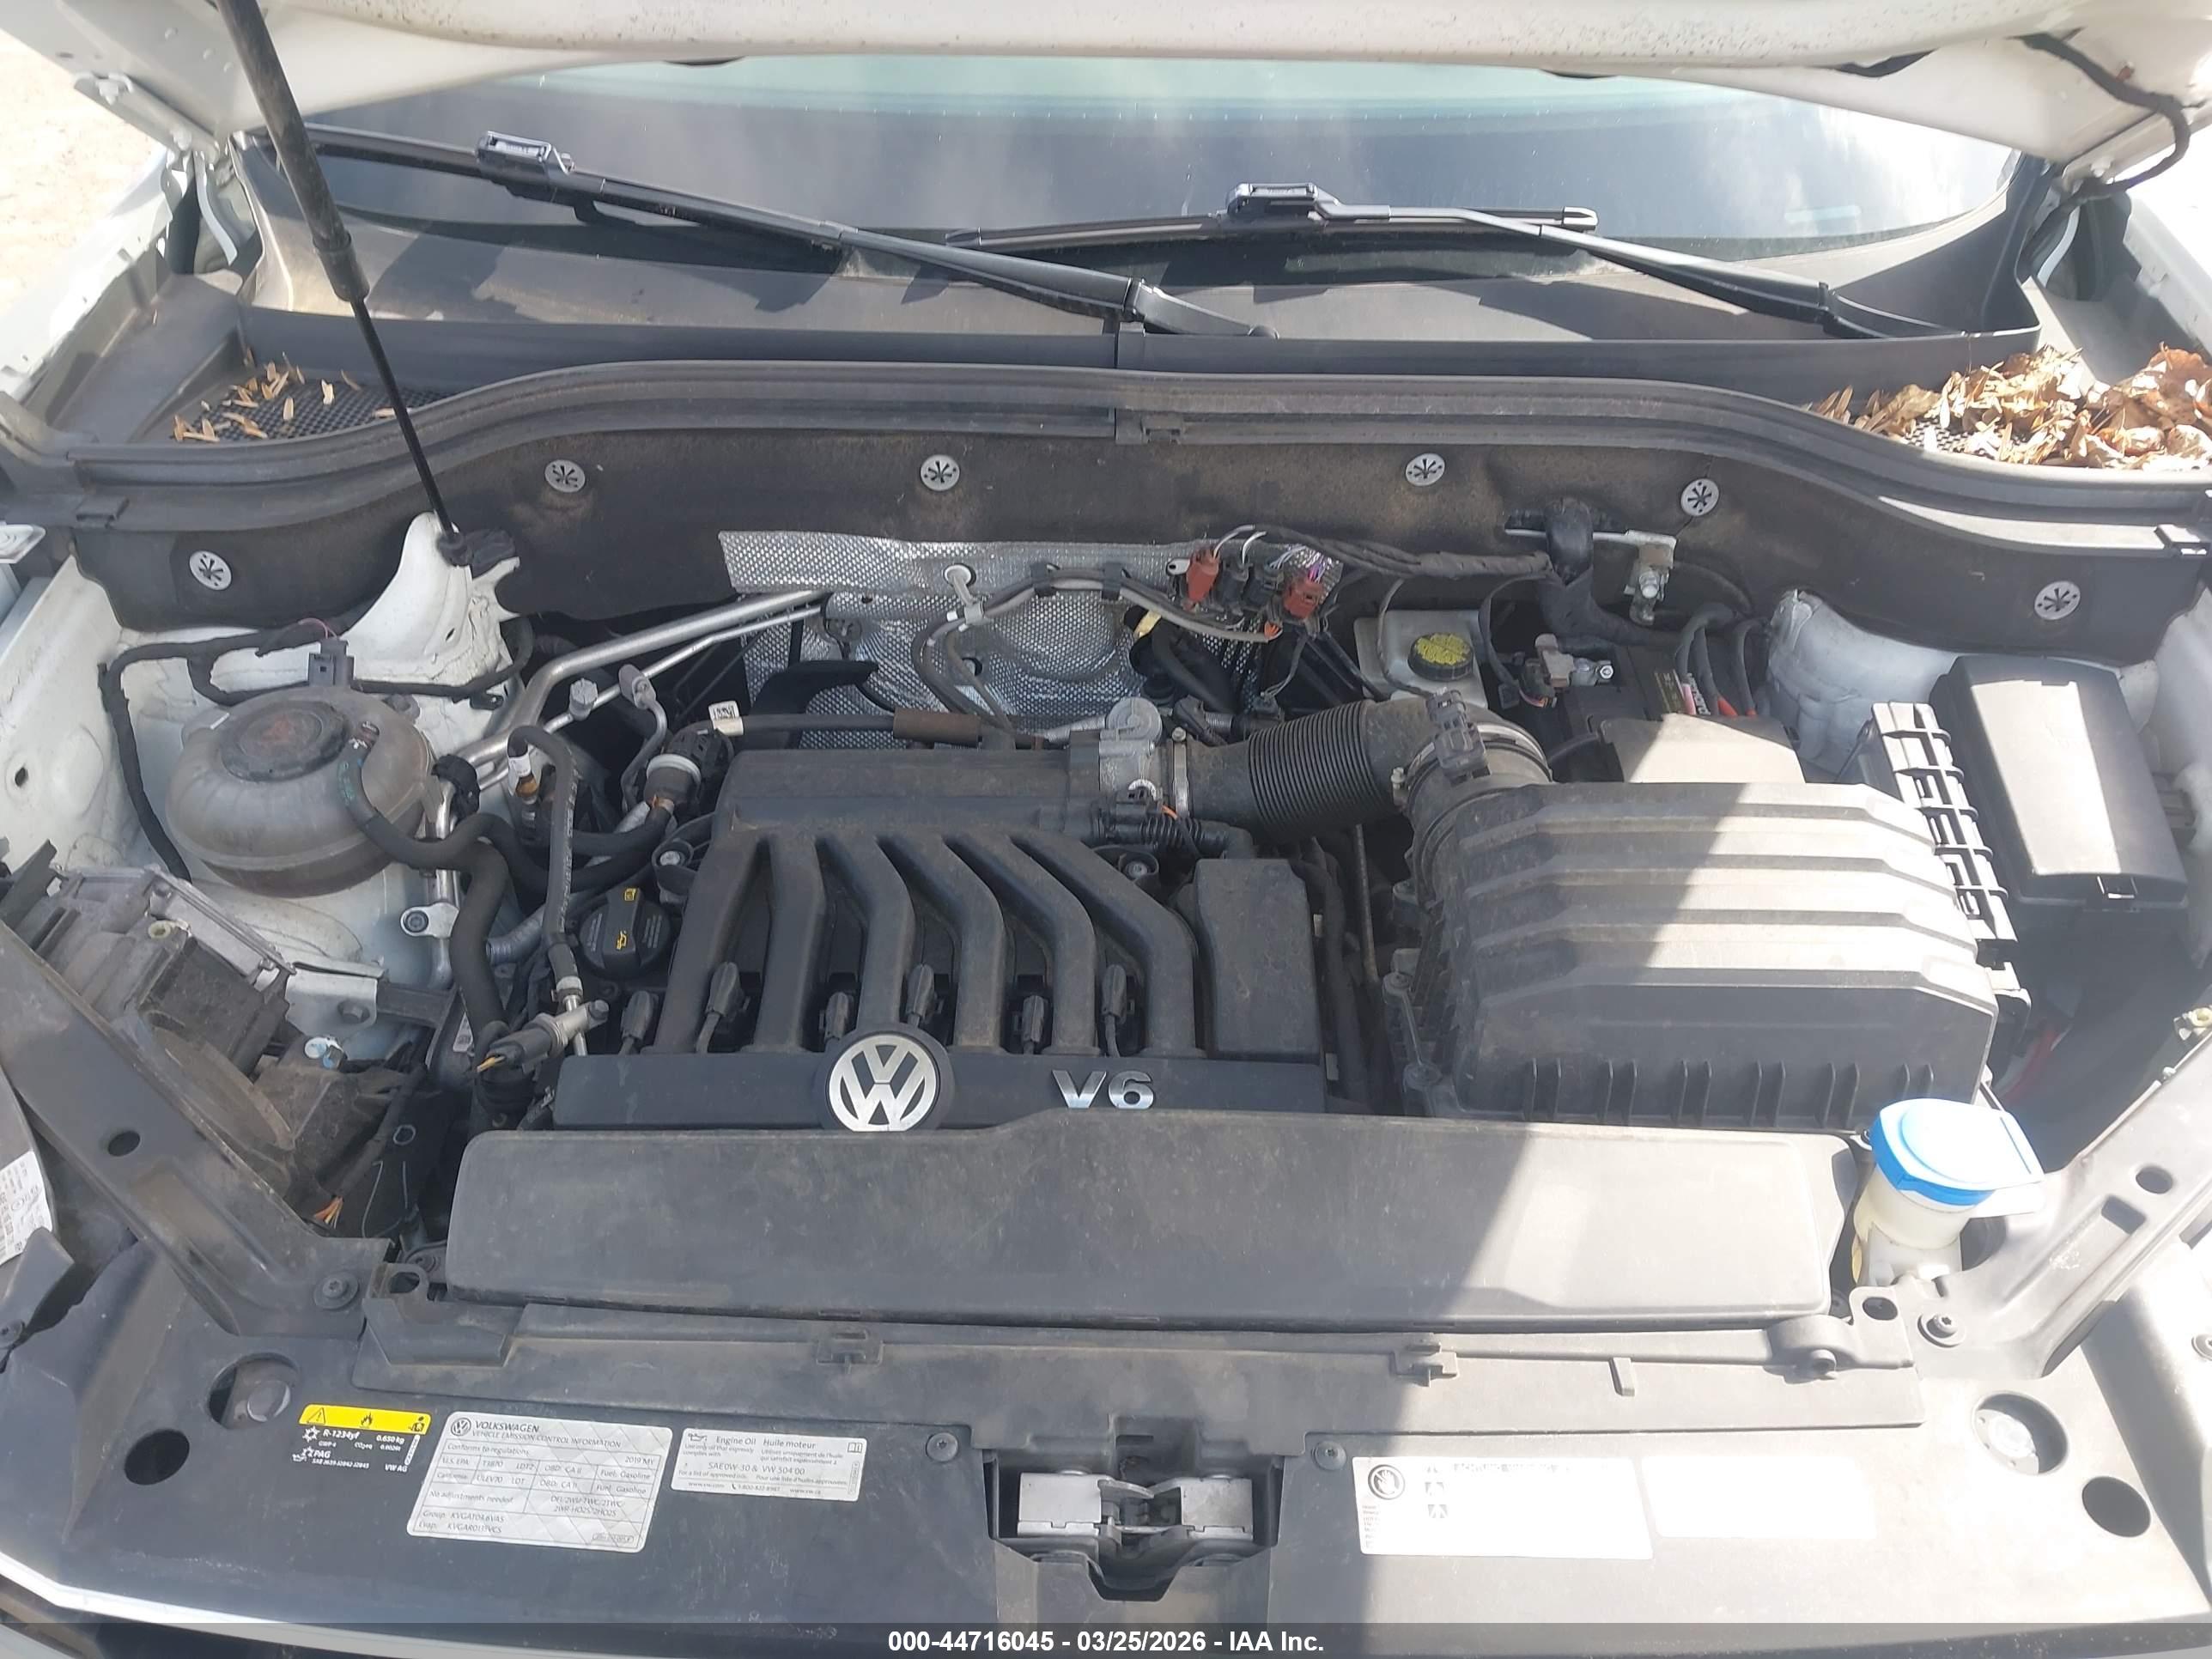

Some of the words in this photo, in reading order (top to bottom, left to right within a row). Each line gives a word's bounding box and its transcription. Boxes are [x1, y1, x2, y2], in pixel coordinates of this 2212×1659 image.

[1052, 1070, 1155, 1109] V6
[475, 1420, 540, 1433] VOLKSWAGEN
[322, 1429, 361, 1441] R-1234yf
[501, 1432, 536, 1442] EMISSION
[537, 1434, 569, 1443] CONTROL
[571, 1437, 622, 1448] INFORMATION
[396, 1437, 405, 1445] kg
[716, 1436, 744, 1446] Engine
[763, 1438, 784, 1447] Huile
[786, 1440, 816, 1449] moteur
[447, 1443, 481, 1451] Conforms
[313, 1449, 331, 1458] PAG
[620, 1471, 651, 1480] Gasoline
[441, 1492, 485, 1501] adjustments
